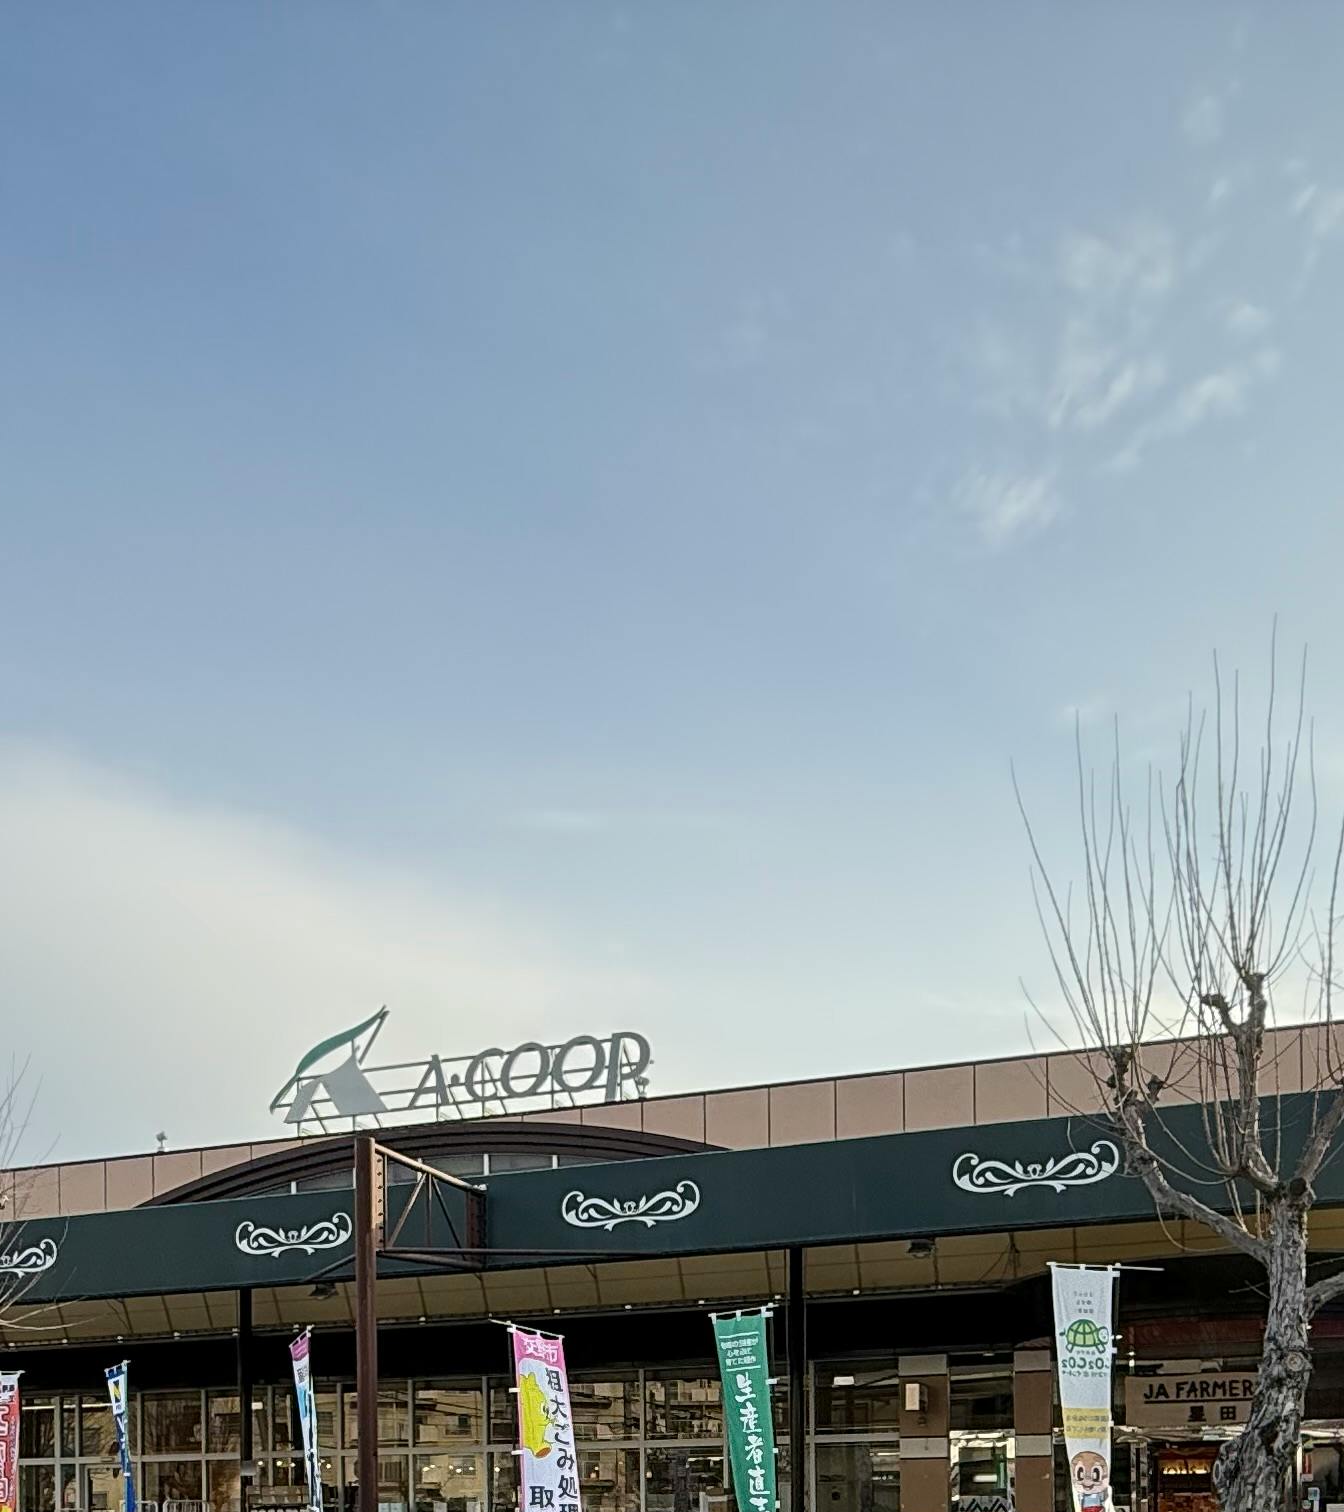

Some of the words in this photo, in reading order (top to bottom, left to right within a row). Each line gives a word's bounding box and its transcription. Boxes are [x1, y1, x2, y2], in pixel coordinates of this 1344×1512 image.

[1143, 1383, 1170, 1399] JA
[1175, 1379, 1255, 1399] FARMER
[1187, 1405, 1237, 1422] 星田
